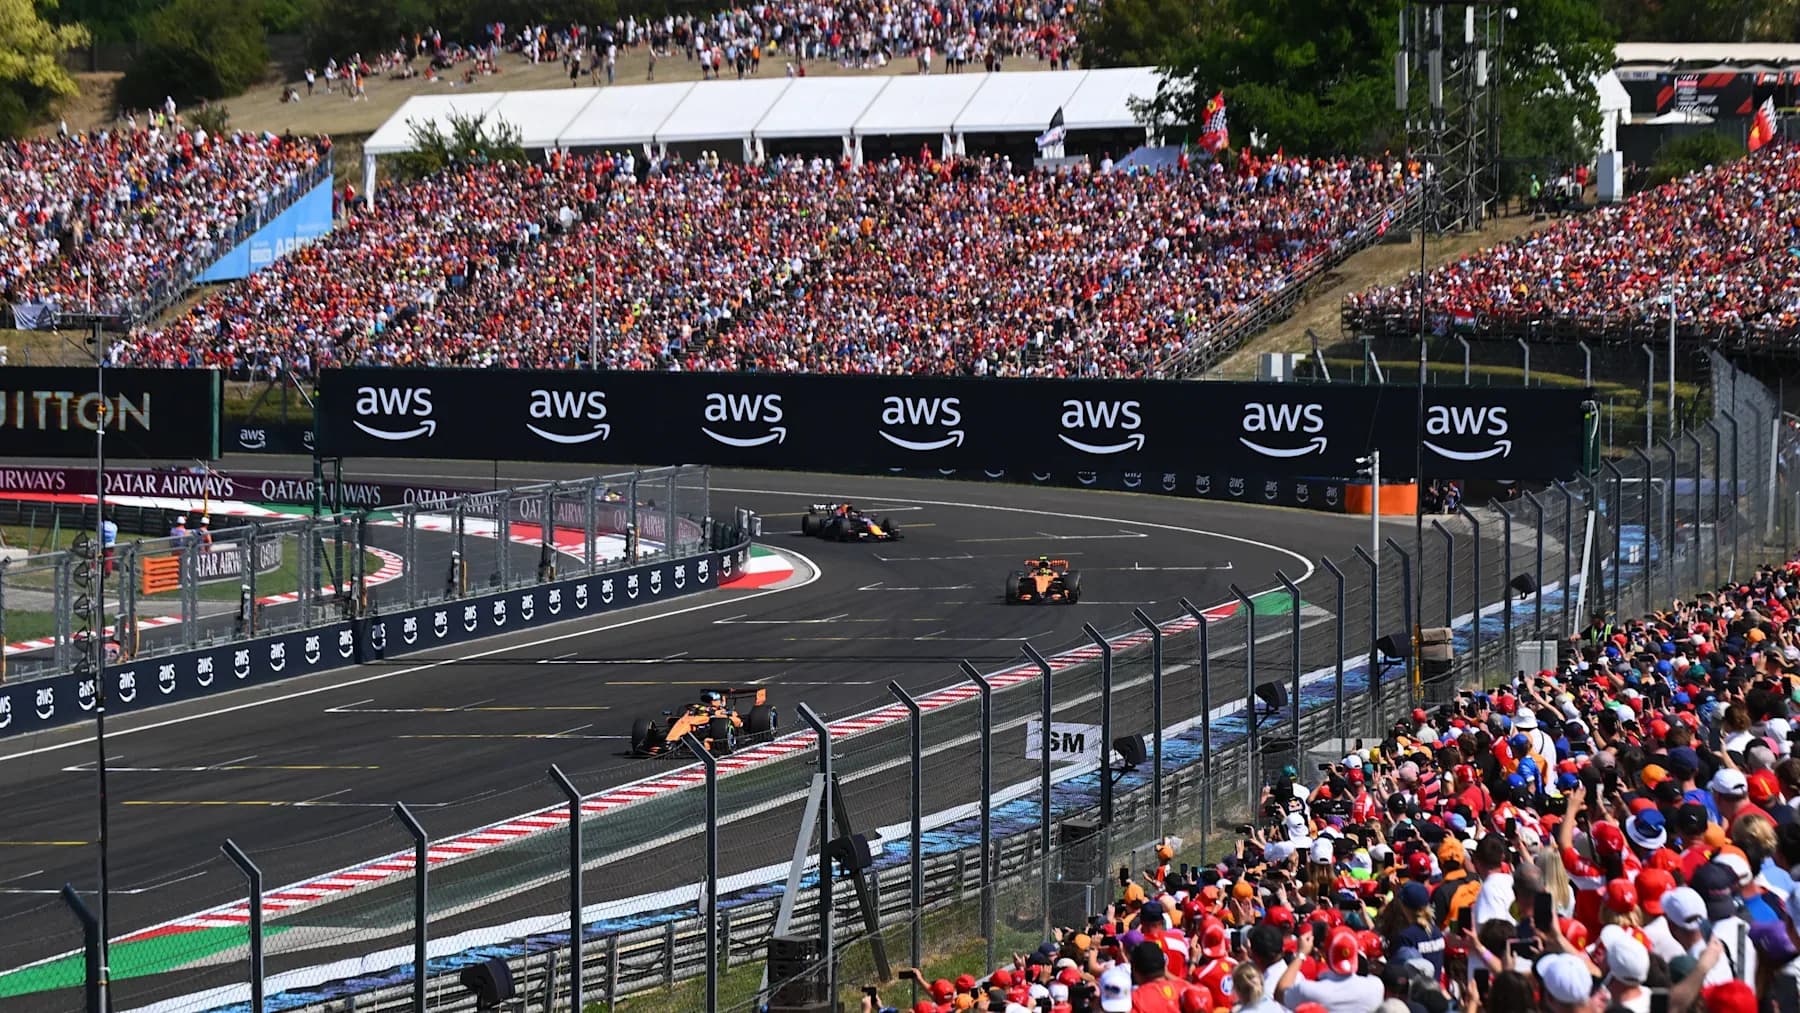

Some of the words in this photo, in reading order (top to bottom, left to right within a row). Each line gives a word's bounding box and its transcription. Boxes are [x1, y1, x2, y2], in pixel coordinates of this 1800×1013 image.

[0, 391, 150, 431] ITTON
[356, 386, 433, 416] aws
[529, 390, 607, 420] aws
[704, 392, 783, 423] aws
[882, 396, 961, 426] aws
[1061, 399, 1142, 430] aws
[1242, 402, 1324, 433] aws
[1426, 405, 1508, 436] aws
[240, 428, 266, 441] aws
[161, 475, 232, 497] AIRWAYS
[261, 479, 315, 501] QATAR
[317, 481, 381, 505] IWAYS
[0, 695, 11, 713] ws
[36, 687, 53, 706] aws
[79, 681, 95, 698] aws
[119, 671, 135, 689] aws
[159, 664, 175, 681] aws
[197, 656, 213, 674] aws
[234, 649, 249, 667] aws
[270, 642, 285, 659] aws
[305, 635, 319, 652] aws
[339, 629, 353, 646] aws
[403, 617, 417, 633] aws
[434, 611, 447, 626] aws
[464, 605, 476, 620] aws
